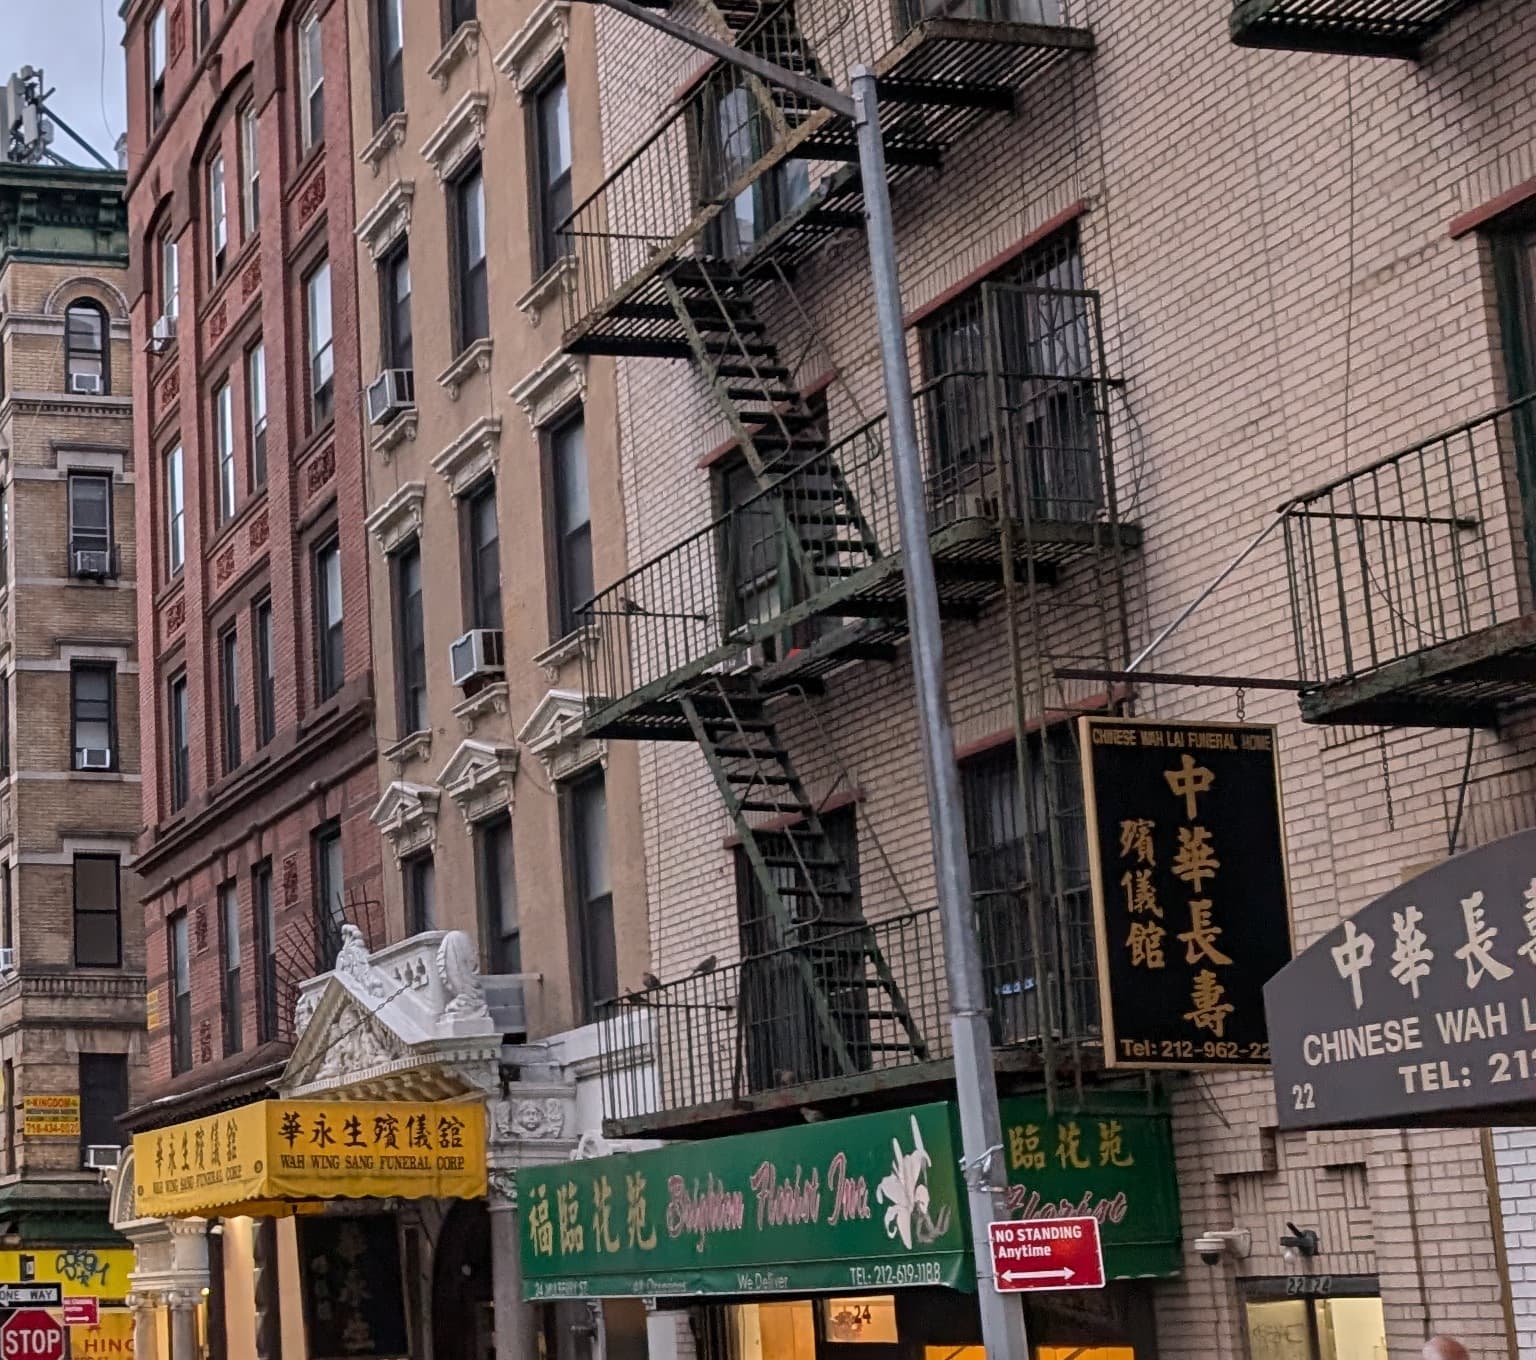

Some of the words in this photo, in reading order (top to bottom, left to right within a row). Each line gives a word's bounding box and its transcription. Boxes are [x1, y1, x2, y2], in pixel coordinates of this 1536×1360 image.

[1092, 728, 1137, 746] CHINESE
[1140, 730, 1164, 747] WAH
[1166, 730, 1184, 748] LAI
[1188, 732, 1238, 750] FUNERAL
[1241, 734, 1272, 751] HOME
[1163, 753, 1235, 1038] 中華長壽
[1302, 1016, 1423, 1066] CHINESE
[1435, 1001, 1508, 1045] WAH
[1120, 1039, 1158, 1058] Tel:
[1398, 1060, 1471, 1094] TEL:
[1292, 1083, 1316, 1111] 22
[280, 1154, 305, 1170] WAH
[310, 1154, 340, 1170] WING
[344, 1154, 374, 1170] SANG
[379, 1155, 433, 1171] FUNERAL
[995, 1228, 1015, 1243] NO
[1016, 1225, 1083, 1242] STANDING
[998, 1244, 1052, 1260] Anytime
[737, 1272, 753, 1290] We
[850, 1266, 872, 1286] TEL:
[873, 1262, 941, 1284] 212-619-1188
[30, 1289, 53, 1300] WAY
[854, 1304, 872, 1325] 24
[5, 1329, 61, 1355] STOP
